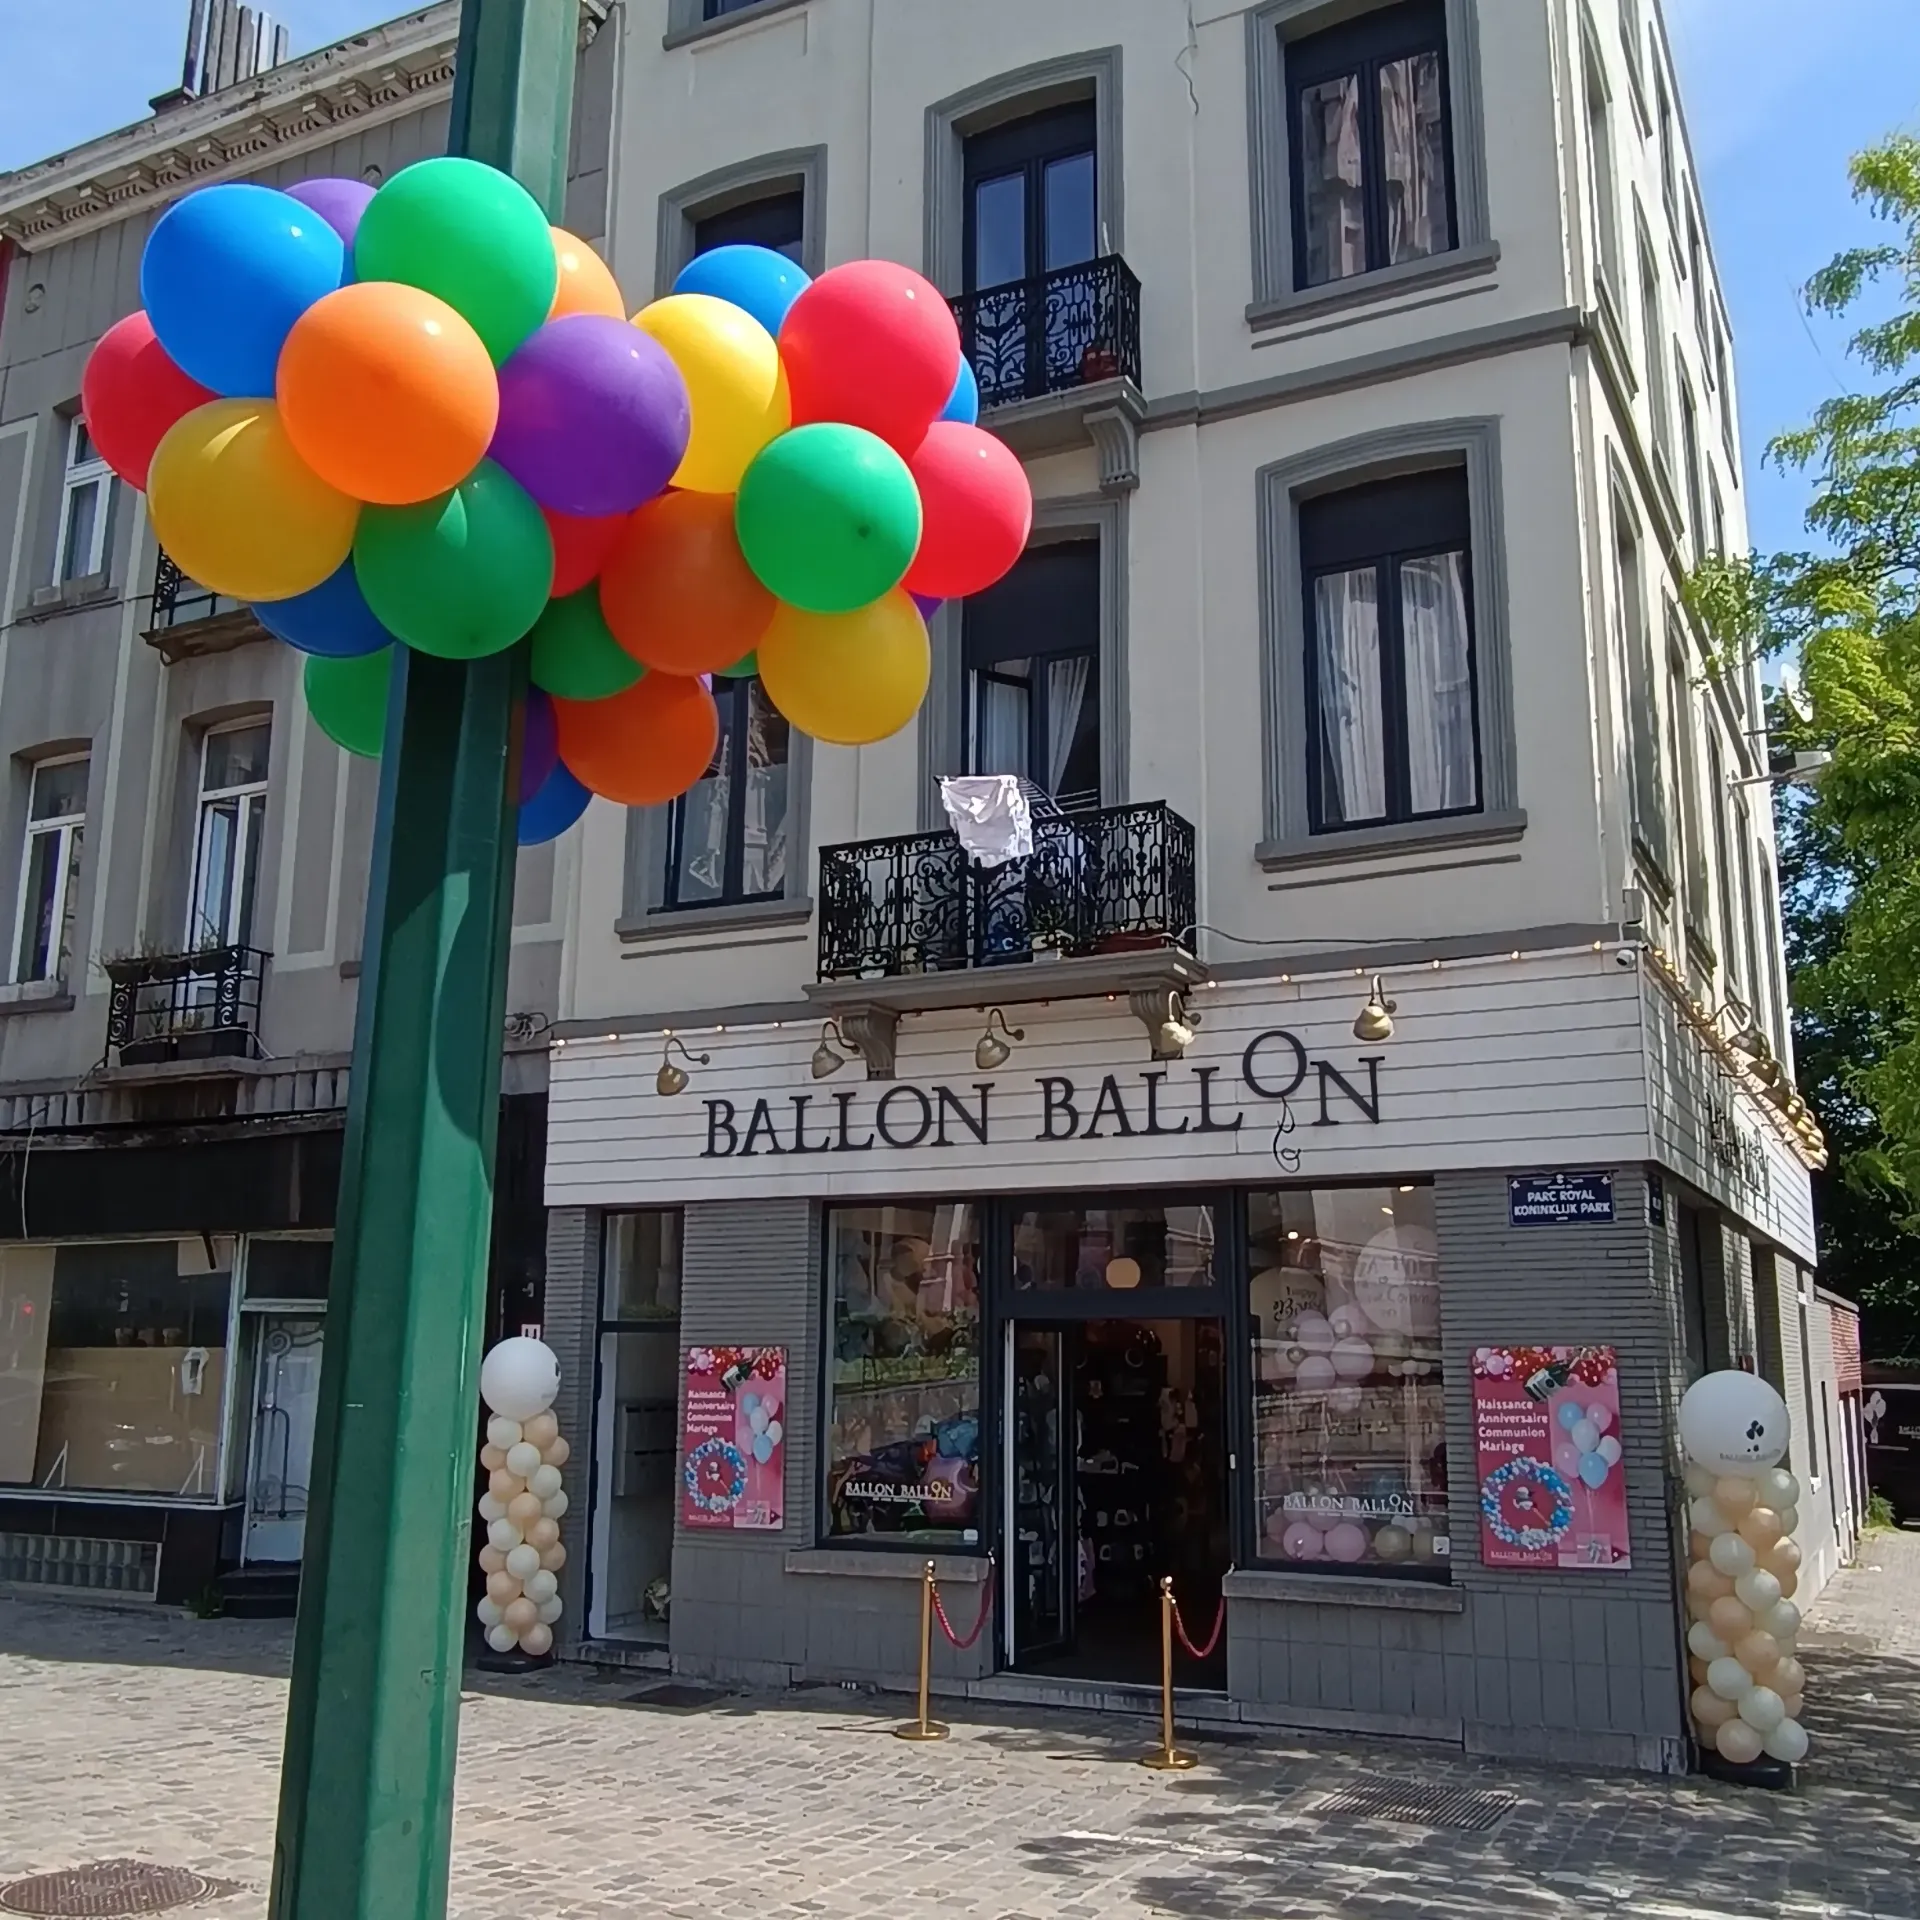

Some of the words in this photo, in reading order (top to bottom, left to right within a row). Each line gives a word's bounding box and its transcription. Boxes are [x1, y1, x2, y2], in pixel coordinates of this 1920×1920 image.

[700, 1082, 995, 1158] BALLON
[1034, 1030, 1386, 1142] BALLON
[1527, 1191, 1557, 1203] PARC
[1559, 1189, 1596, 1201] ROYAL
[1580, 1202, 1611, 1214] PARK
[1477, 1398, 1534, 1410] Naissance
[1478, 1412, 1549, 1424] Anniversaire
[1478, 1425, 1546, 1438] Communion
[1479, 1440, 1525, 1455] Mariage
[845, 1481, 896, 1496] BALLON
[900, 1480, 952, 1499] BALLON
[1283, 1495, 1344, 1510] BALLON
[1351, 1493, 1414, 1513] BALLON
